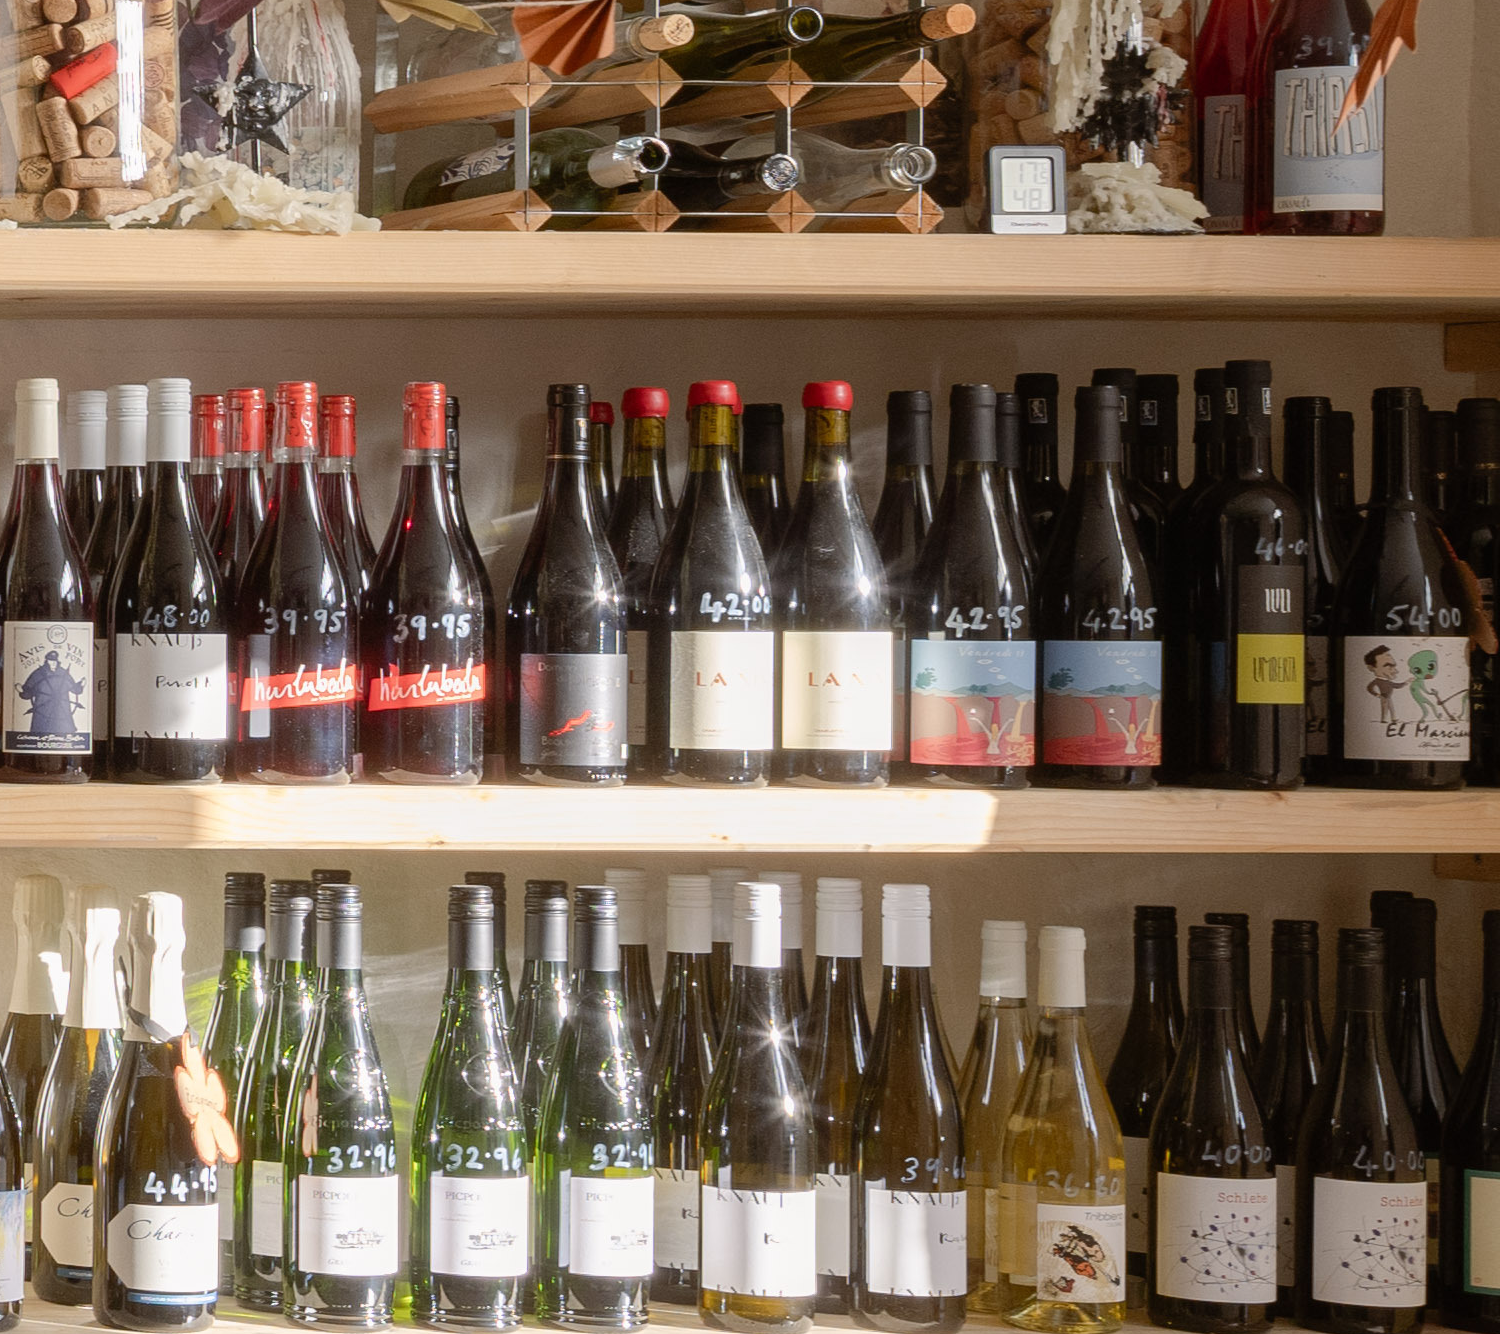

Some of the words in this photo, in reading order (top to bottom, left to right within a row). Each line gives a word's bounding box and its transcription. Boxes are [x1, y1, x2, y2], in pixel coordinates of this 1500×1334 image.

[1013, 188, 1042, 210] 48
[142, 605, 211, 634] 48.00
[263, 608, 346, 636] 39.95
[393, 614, 473, 643] 39.95
[945, 605, 1026, 638] 42.95
[1386, 604, 1461, 632] 54.00
[18, 643, 46, 663] AVIS
[66, 643, 85, 658] VIN
[1386, 722, 1404, 738] El
[1415, 722, 1470, 738] Marcian
[1202, 1140, 1272, 1167] 40.00
